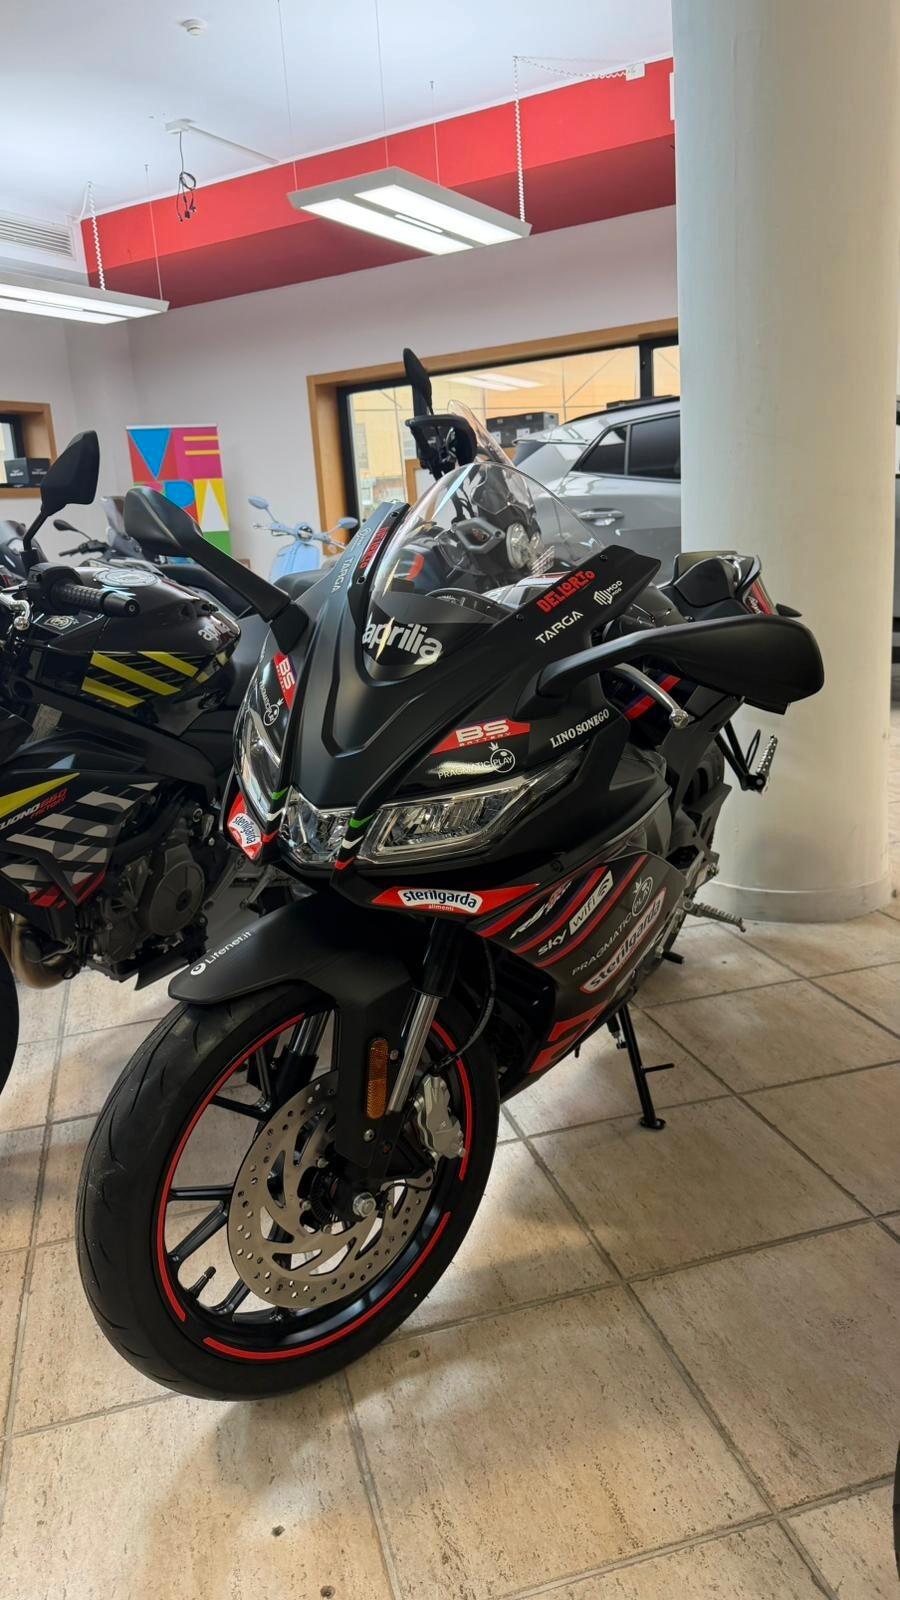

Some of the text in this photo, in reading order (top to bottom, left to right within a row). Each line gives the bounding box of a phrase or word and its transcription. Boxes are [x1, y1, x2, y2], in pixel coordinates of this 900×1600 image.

[362, 623, 442, 658] aprilia
[535, 610, 584, 644] TARGA
[279, 657, 295, 689] BS
[455, 719, 510, 743] BS
[550, 708, 610, 749] LINO SONEGO
[437, 756, 514, 780] PRAGMATIC PLAY
[403, 890, 477, 909] sterilgarda
[538, 929, 567, 956] sky
[572, 912, 633, 975] PRAGMATIC
[590, 899, 662, 988] sterilgarda
